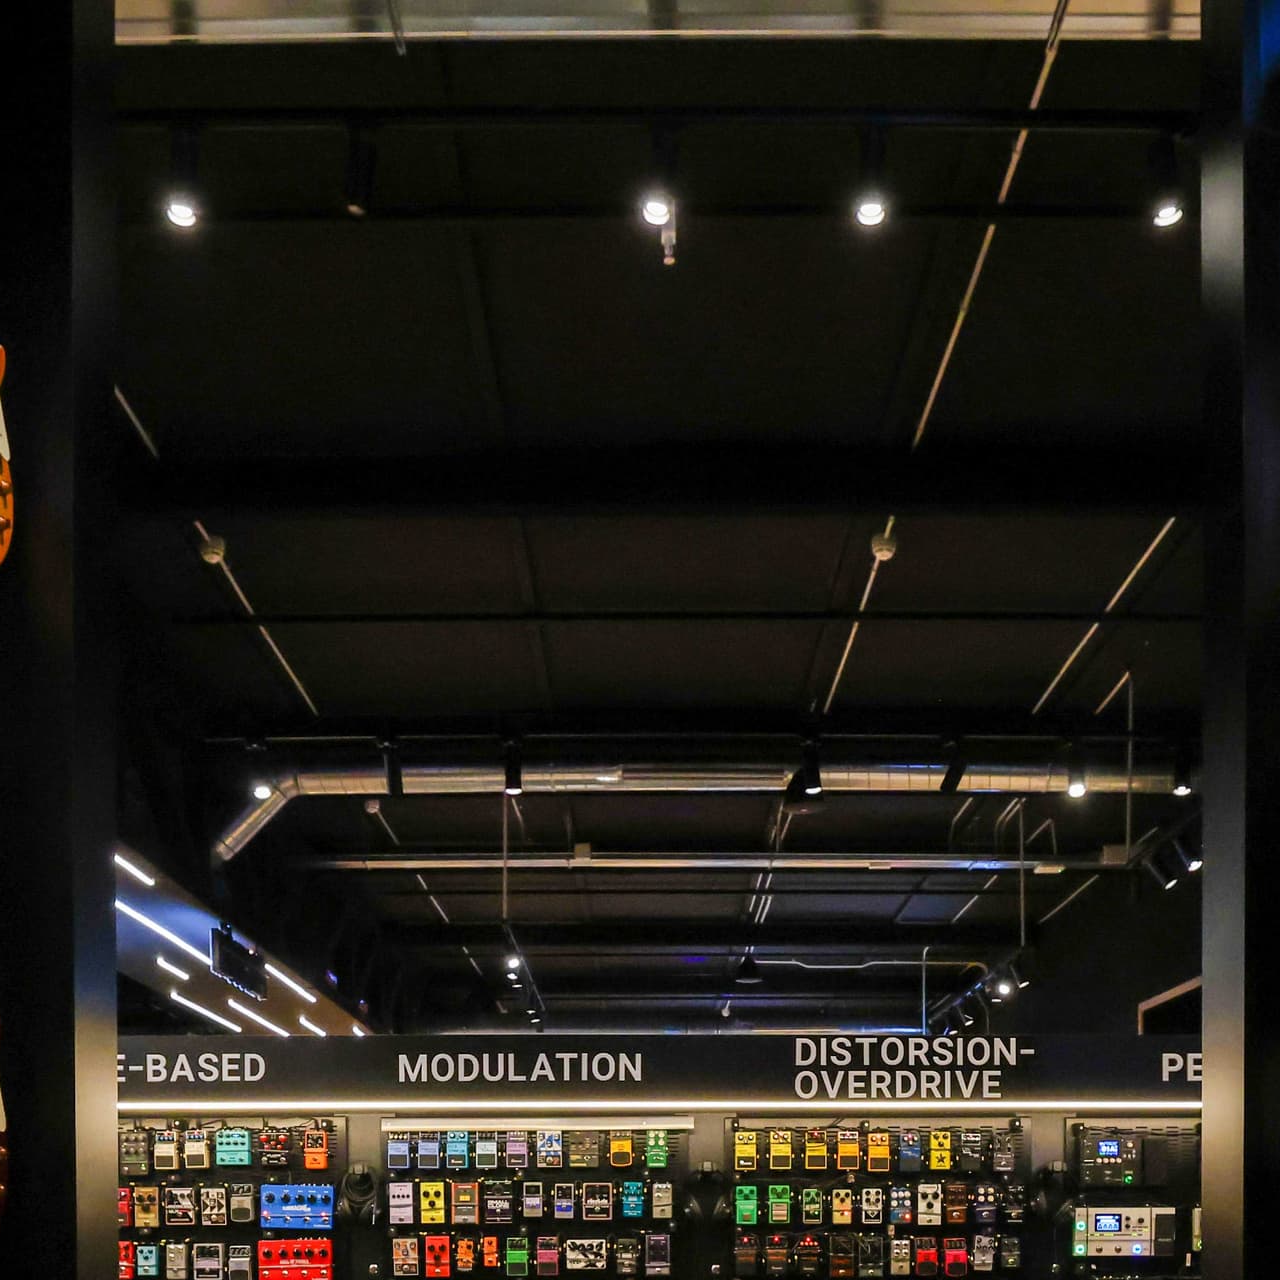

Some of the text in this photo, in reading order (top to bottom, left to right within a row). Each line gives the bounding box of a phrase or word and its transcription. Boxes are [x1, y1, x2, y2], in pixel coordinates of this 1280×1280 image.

[795, 1037, 1035, 1067] DISTORSION-
[398, 1053, 643, 1083] MODULATION
[1162, 1053, 1202, 1083] PE
[795, 1070, 1002, 1099] OVERDRIVE
